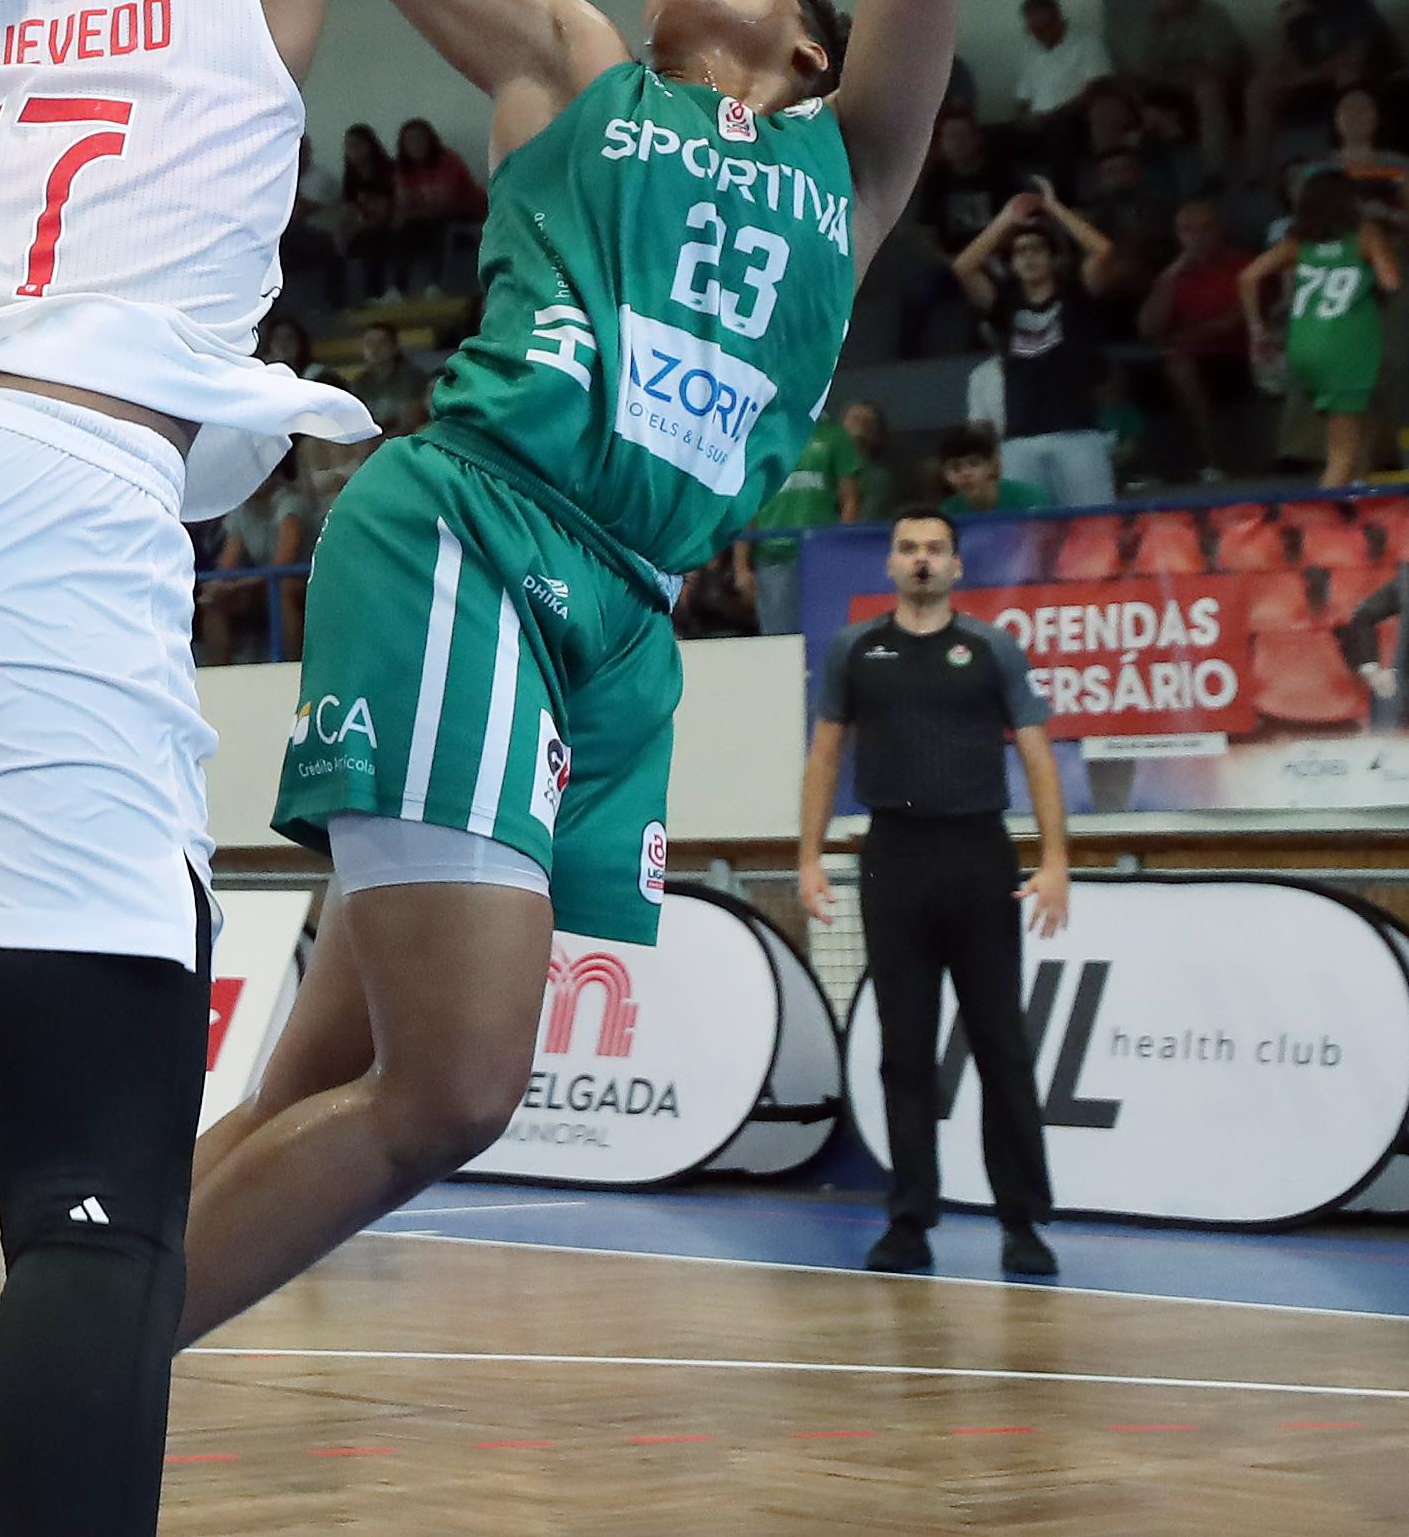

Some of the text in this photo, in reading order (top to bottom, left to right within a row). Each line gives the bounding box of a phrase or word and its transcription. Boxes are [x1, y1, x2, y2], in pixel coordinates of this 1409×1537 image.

[601, 117, 849, 257] SPORTIVA
[670, 201, 792, 340] 23
[1291, 263, 1361, 321] 79
[522, 574, 569, 621] DHIKA
[994, 597, 1222, 655] OFENDAS
[315, 694, 379, 750] CA
[1110, 1025, 1236, 1064] health
[1256, 1028, 1343, 1068] club
